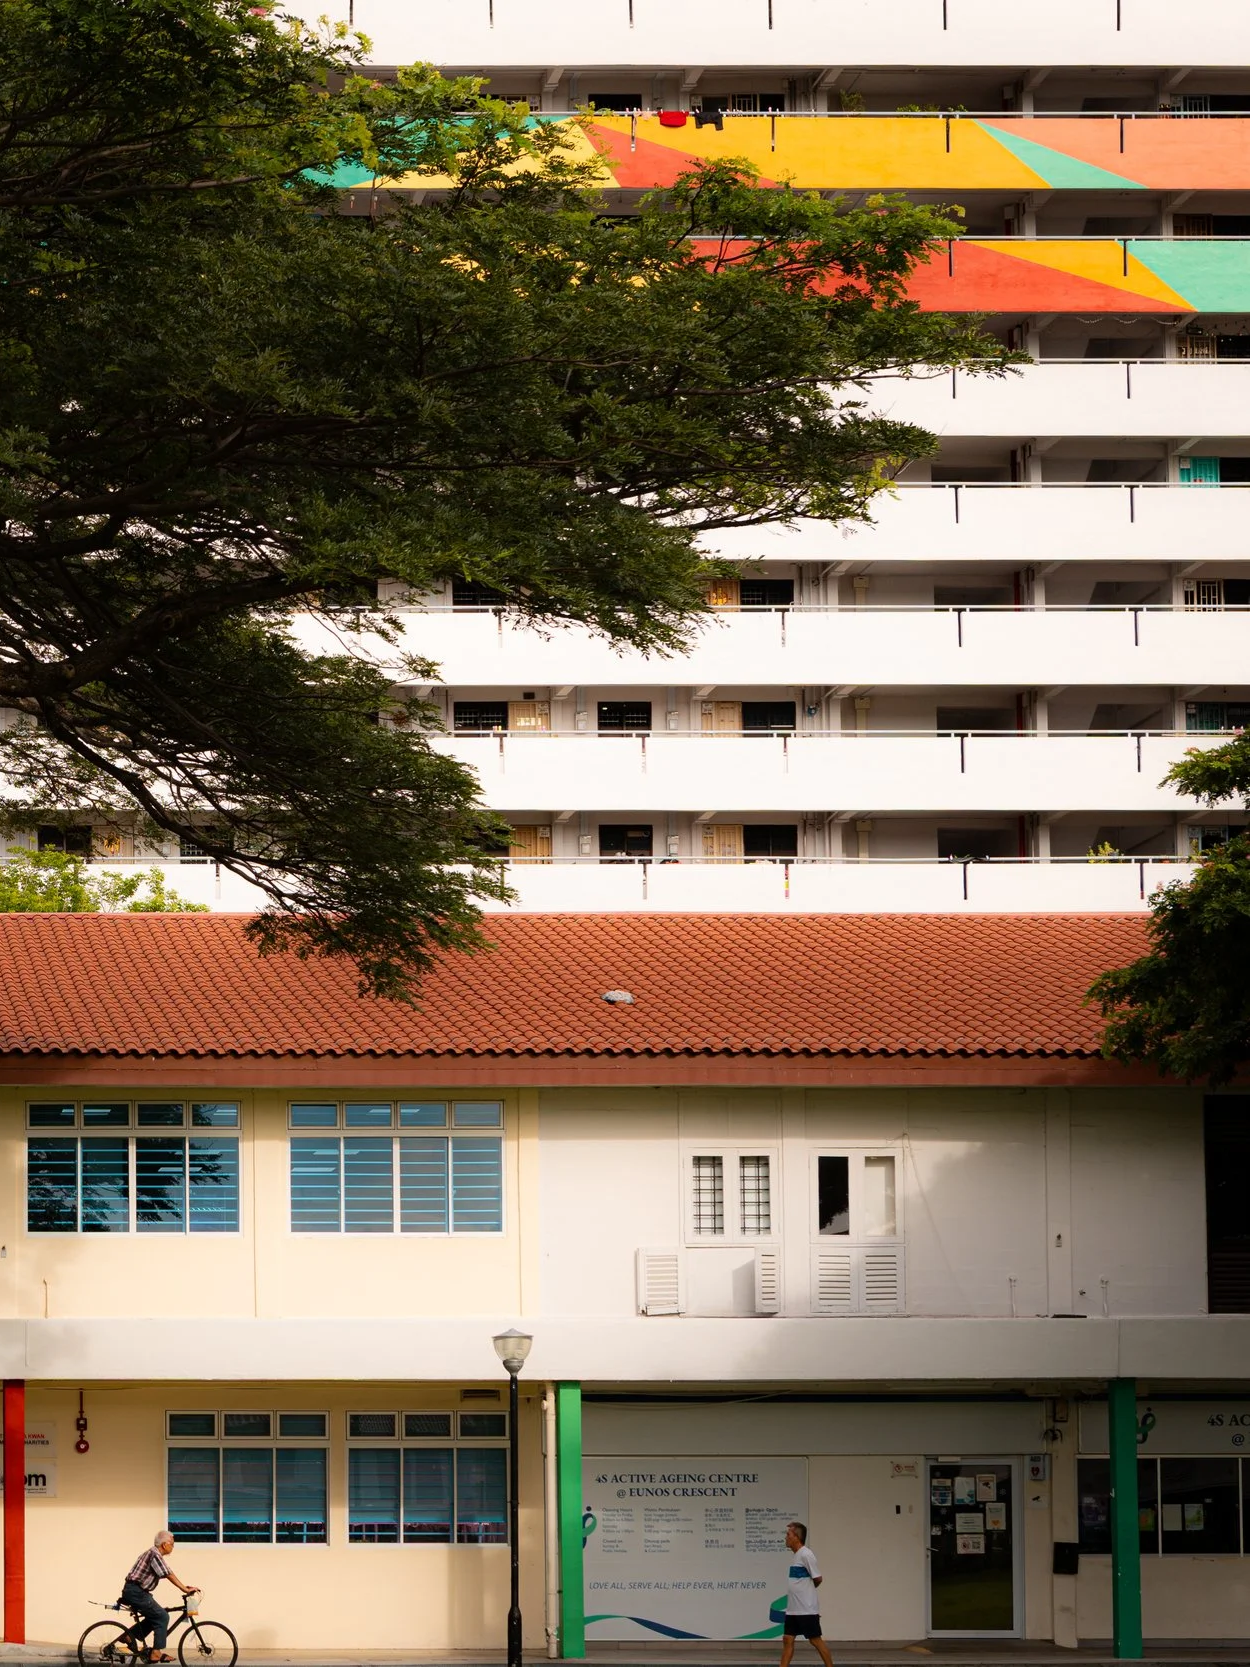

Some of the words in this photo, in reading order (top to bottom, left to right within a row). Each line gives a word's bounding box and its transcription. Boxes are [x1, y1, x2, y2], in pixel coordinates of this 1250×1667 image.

[1207, 1413, 1224, 1427] 4S
[1231, 1433, 1245, 1446] @
[595, 1473, 608, 1483] 4S
[610, 1473, 656, 1483] ACTIVE
[659, 1473, 706, 1484] AGEING
[708, 1473, 759, 1484] CENTRE
[616, 1489, 627, 1499] @
[629, 1487, 670, 1497] EUNOS
[672, 1487, 738, 1497] CRESCENT
[589, 1582, 609, 1590] LOVE
[610, 1582, 626, 1591] ALL,
[628, 1582, 652, 1590] SERVE
[672, 1582, 692, 1590] HELP
[693, 1582, 714, 1591] EVER,
[717, 1581, 738, 1590] HURT
[740, 1581, 767, 1590] NEVER
